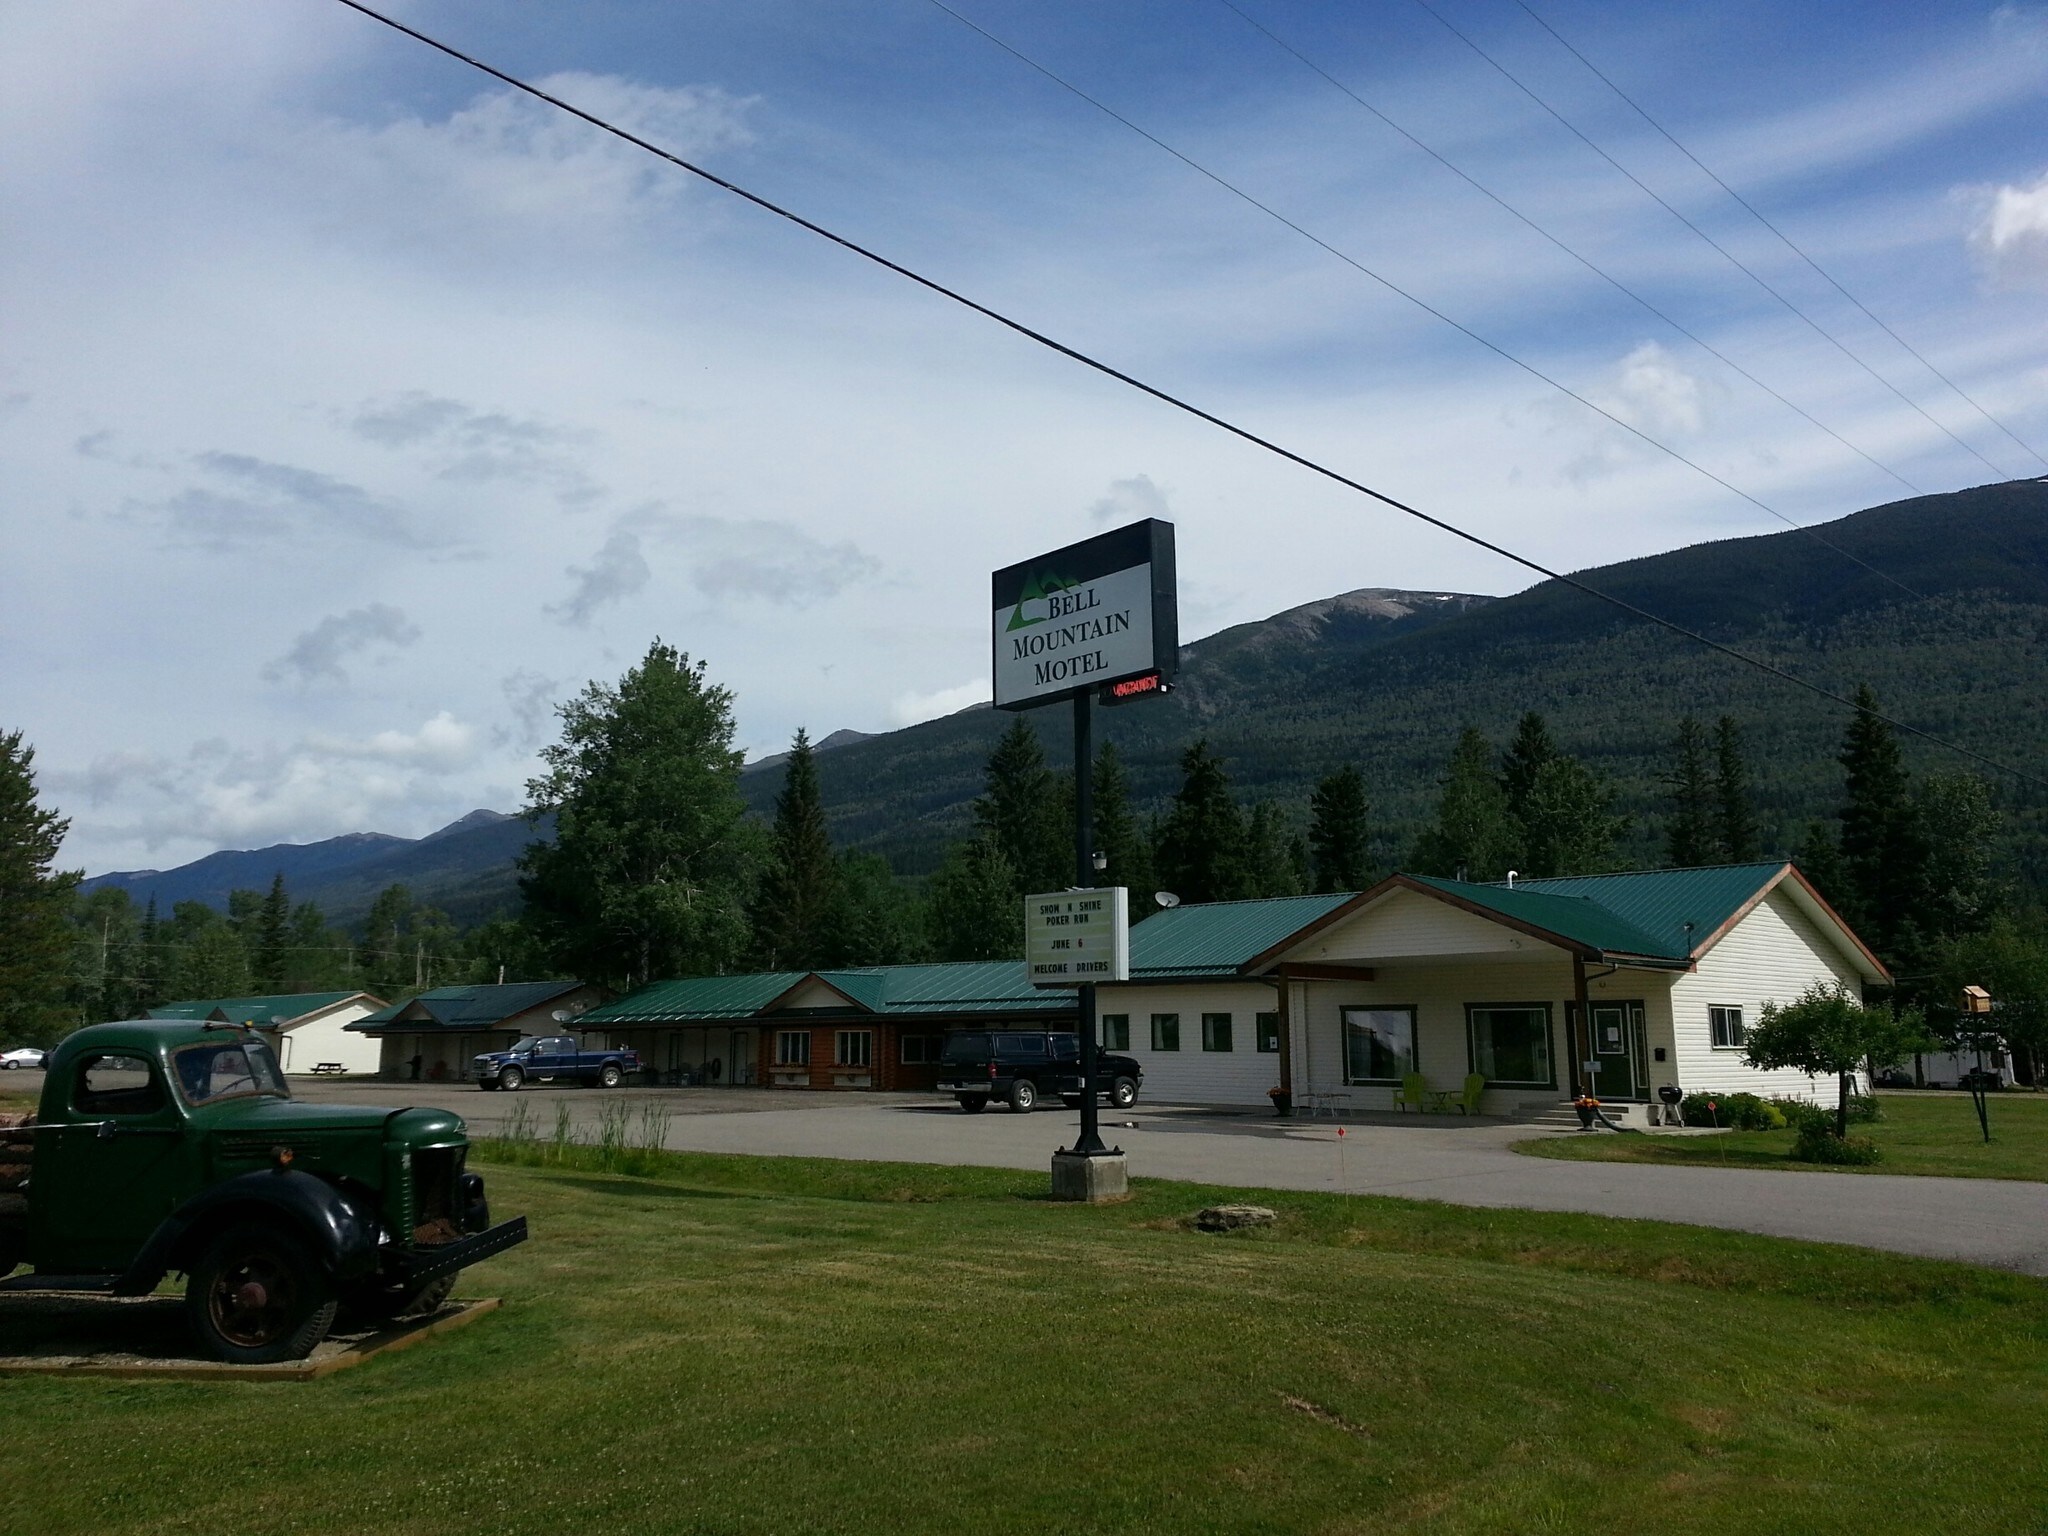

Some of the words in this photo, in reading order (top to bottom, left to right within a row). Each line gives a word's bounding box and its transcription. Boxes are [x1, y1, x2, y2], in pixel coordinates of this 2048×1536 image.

[1048, 588, 1101, 620] BELL
[1013, 609, 1131, 660] MOUNTAIN
[1034, 650, 1109, 686] MOTEL
[1040, 903, 1060, 915] SHOW
[1067, 902, 1073, 913] N
[1079, 900, 1102, 912] SHINE
[1046, 915, 1070, 926] POKER
[1074, 913, 1089, 924] RUN
[1051, 939, 1070, 950] JUNE
[1078, 938, 1083, 948] 6
[1034, 963, 1068, 974] WELCOME
[1076, 961, 1108, 973] DRIVERS
